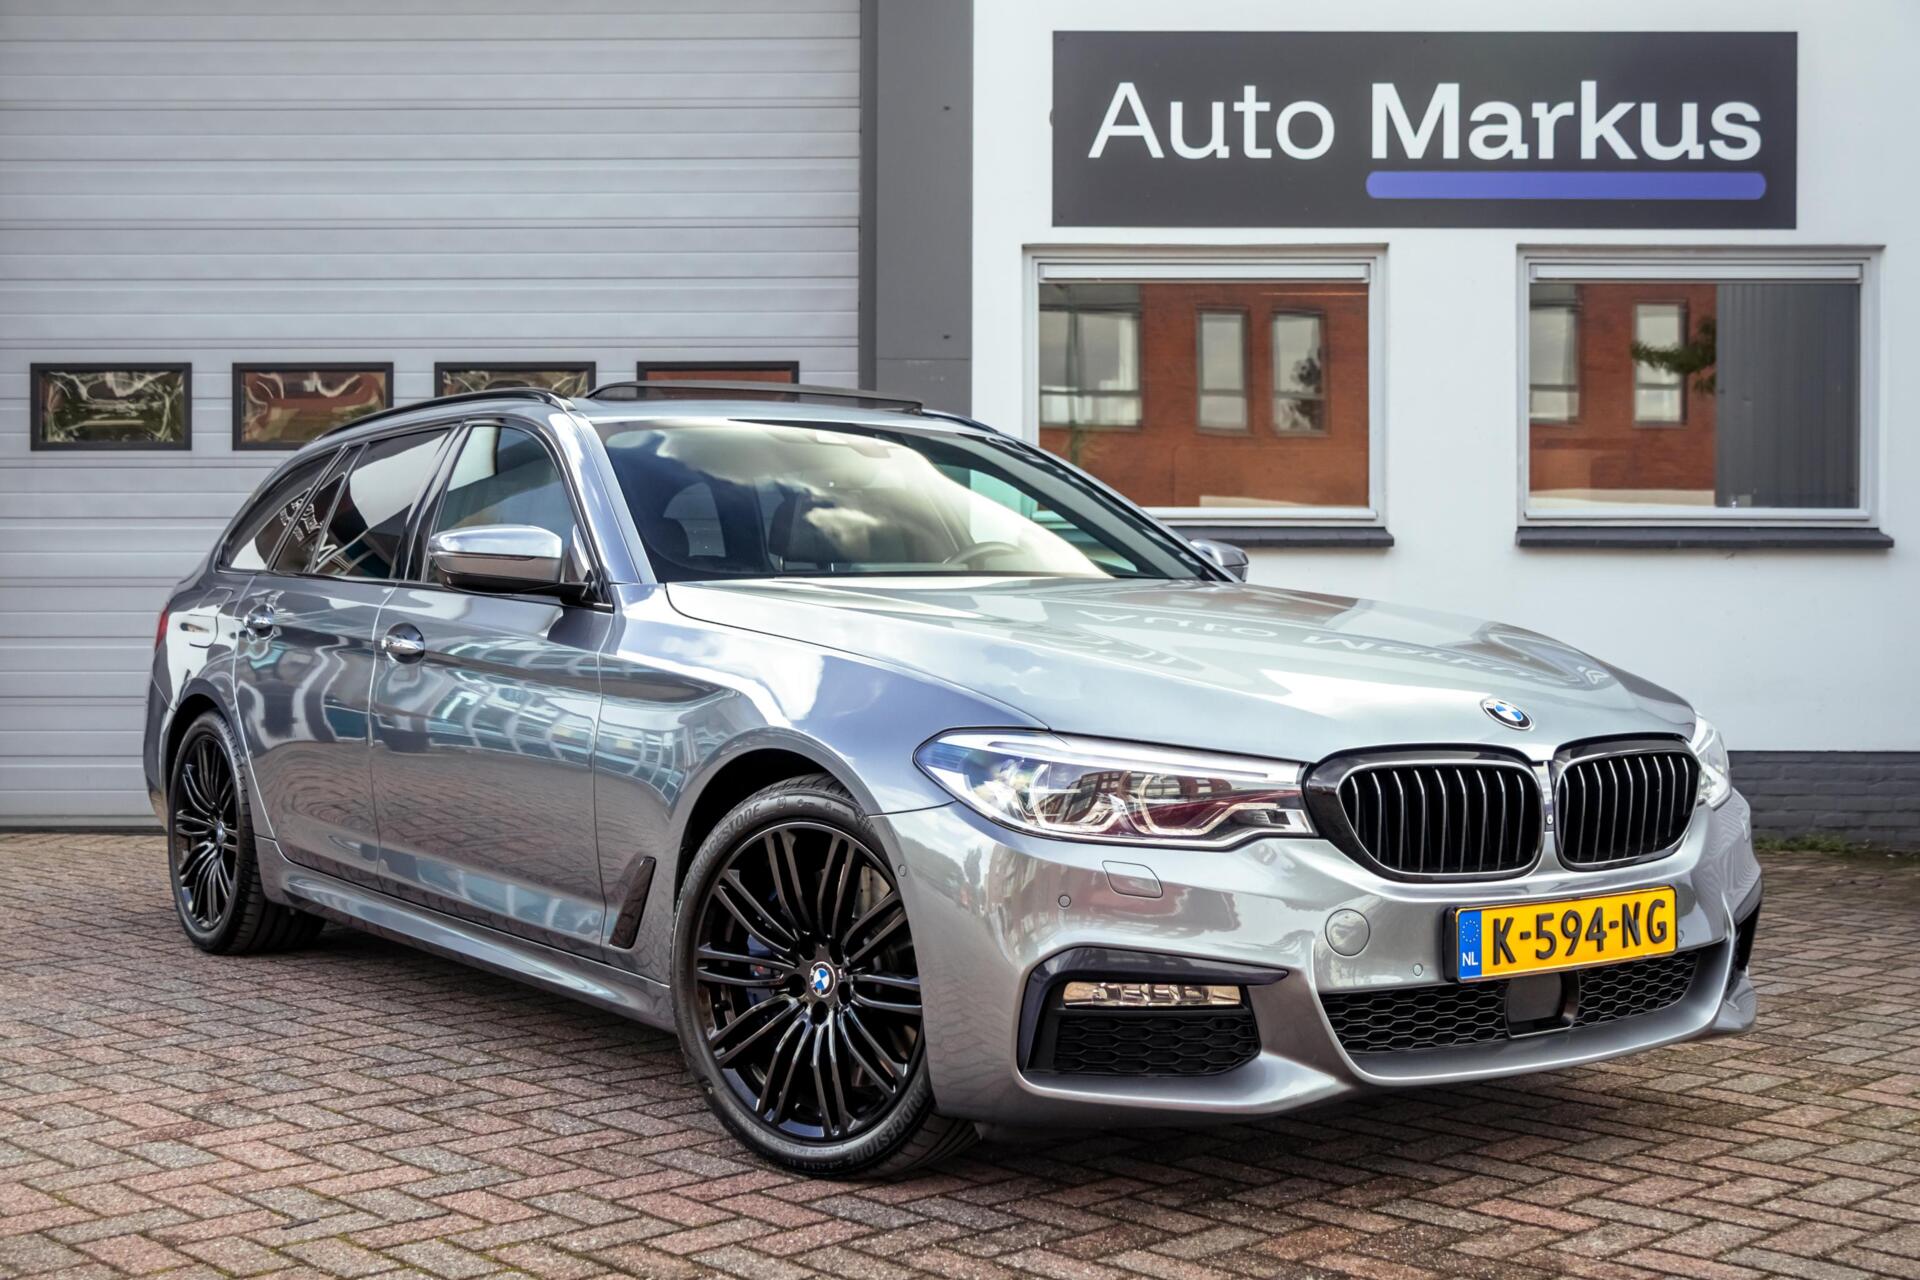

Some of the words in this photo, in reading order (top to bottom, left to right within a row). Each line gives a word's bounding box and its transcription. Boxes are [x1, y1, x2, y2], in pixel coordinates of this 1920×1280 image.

[1088, 82, 1335, 159] Auto
[1371, 80, 1762, 160] Markus
[683, 803, 761, 897] BRIDGESTONE
[1462, 951, 1479, 967] NL
[1492, 899, 1668, 966] K-594-NG
